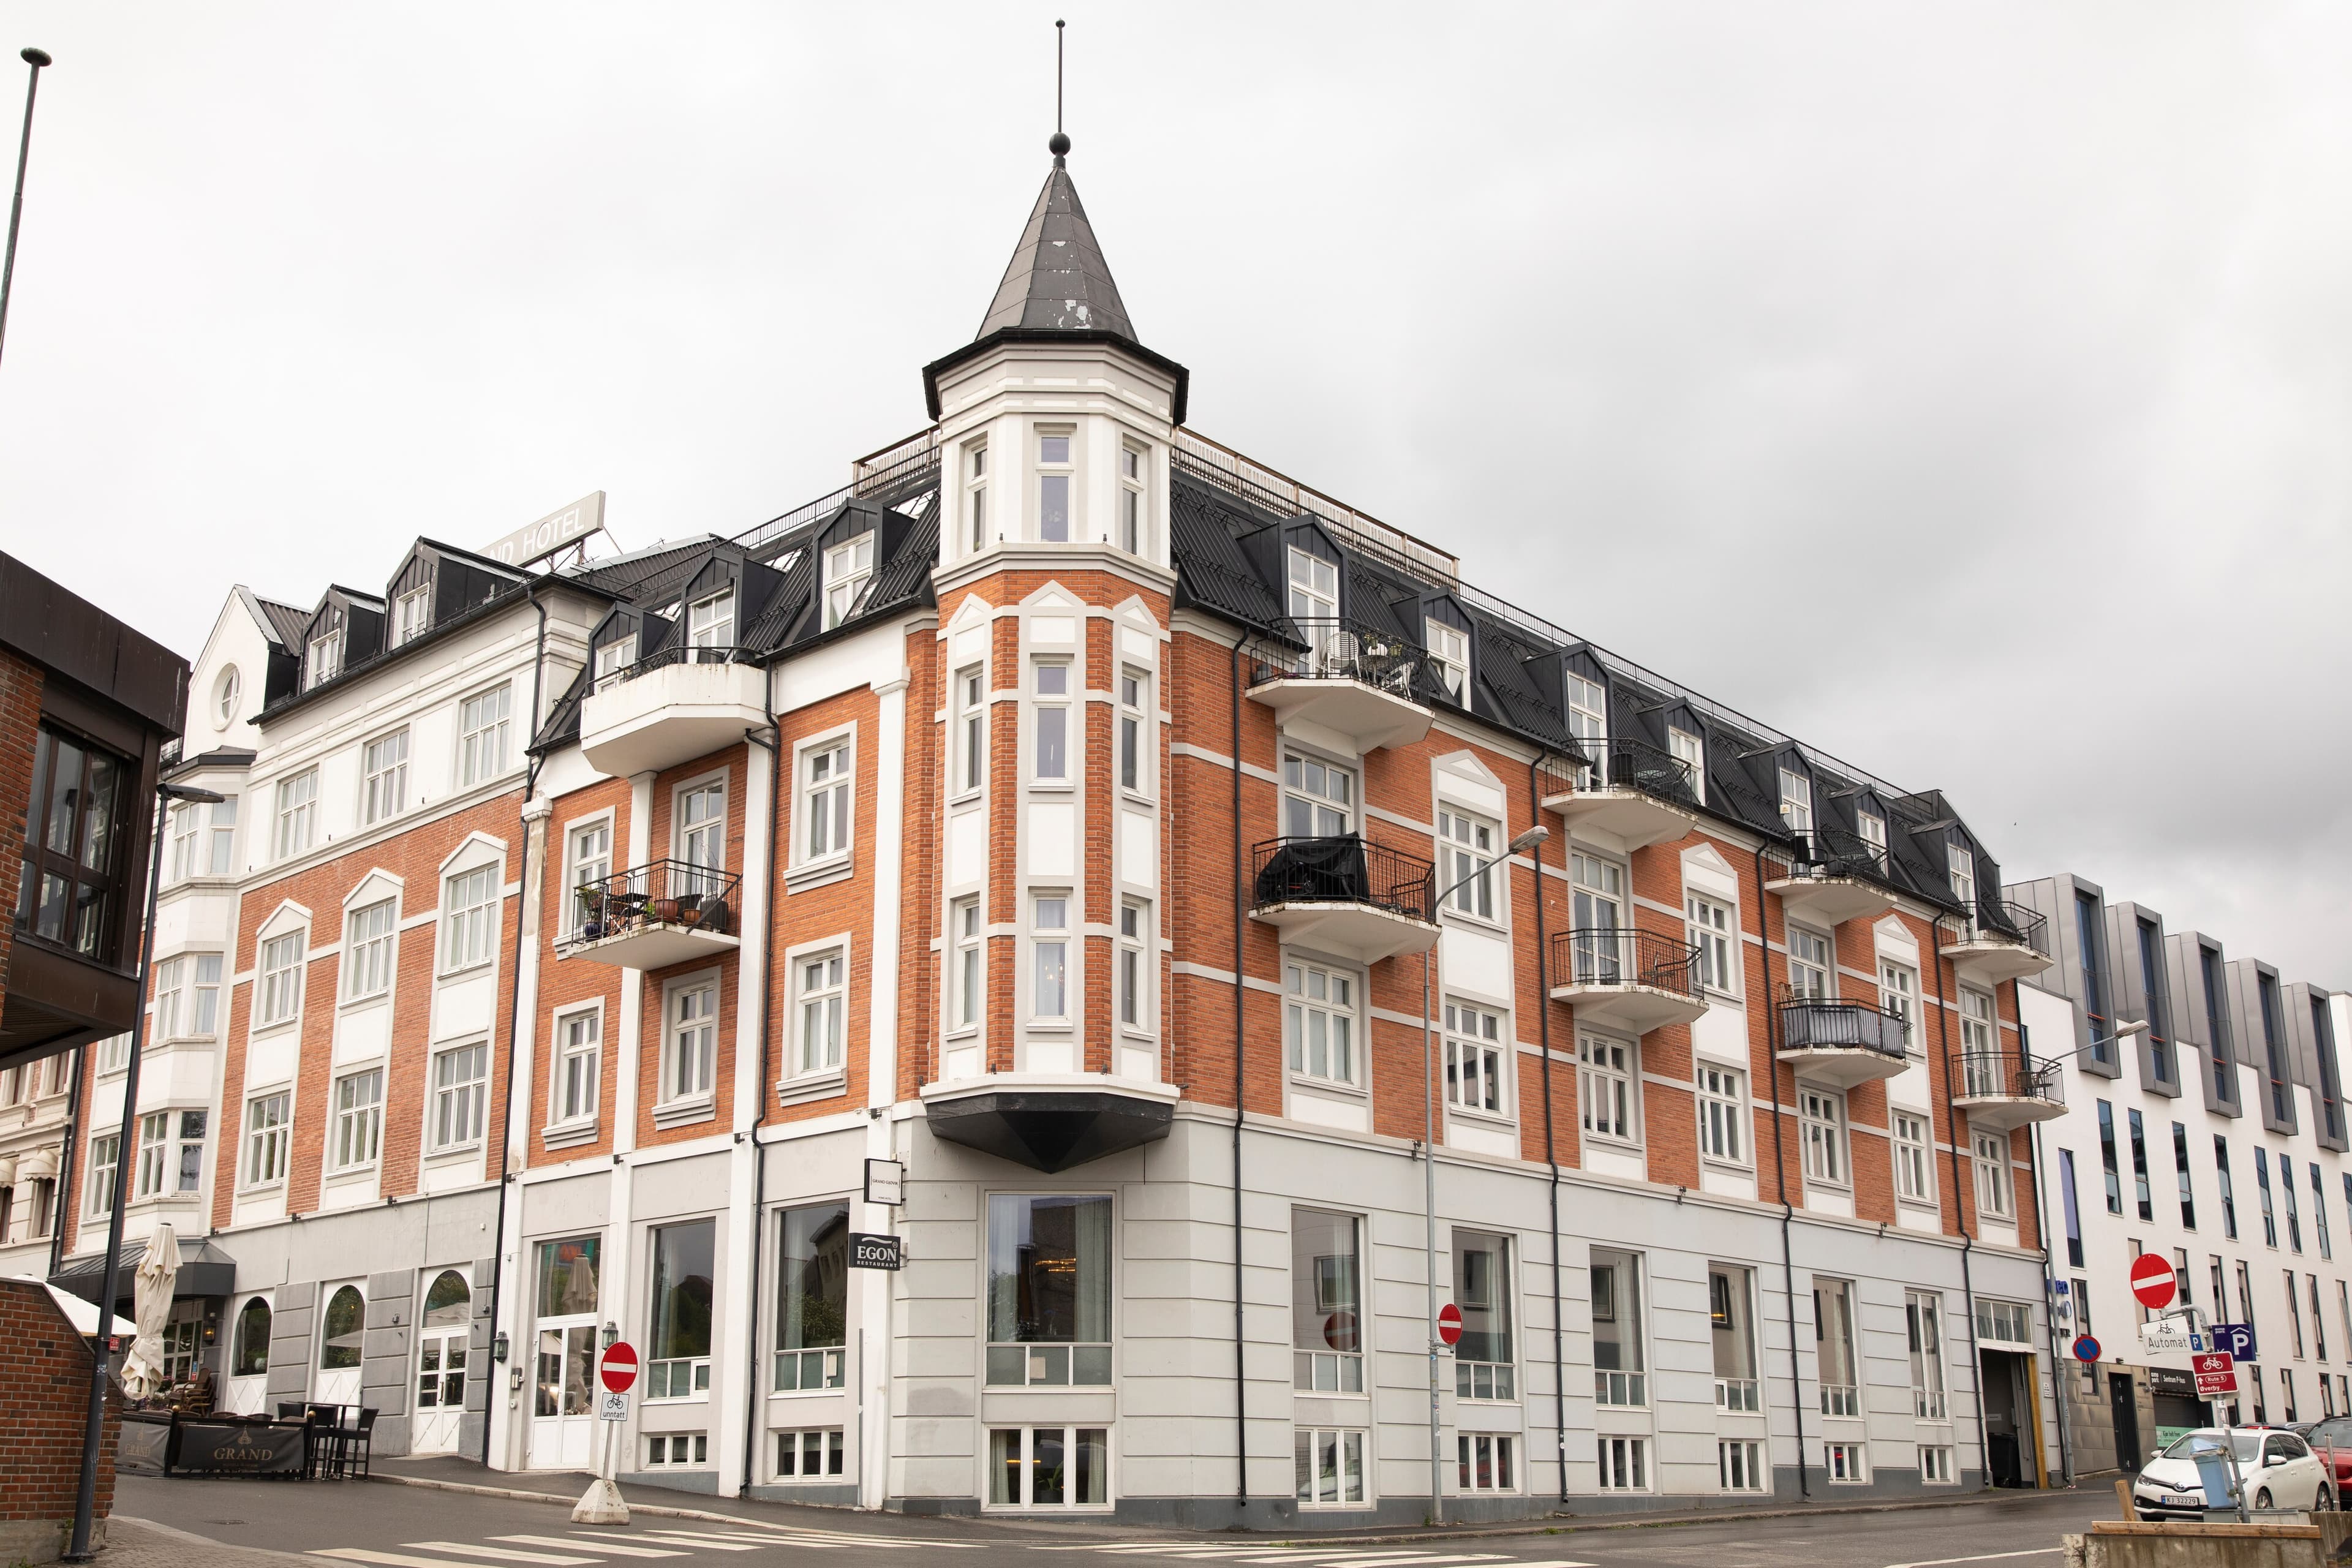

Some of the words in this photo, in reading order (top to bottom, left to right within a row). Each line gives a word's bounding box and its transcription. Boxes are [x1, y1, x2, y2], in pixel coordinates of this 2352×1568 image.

[523, 508, 584, 557] HOTEL
[858, 1246, 897, 1261] EGON
[2149, 1337, 2187, 1348] Automat
[2193, 1337, 2199, 1348] P
[2233, 1334, 2248, 1355] P
[125, 1444, 150, 1457] GRAND
[214, 1448, 273, 1461] GRAND
